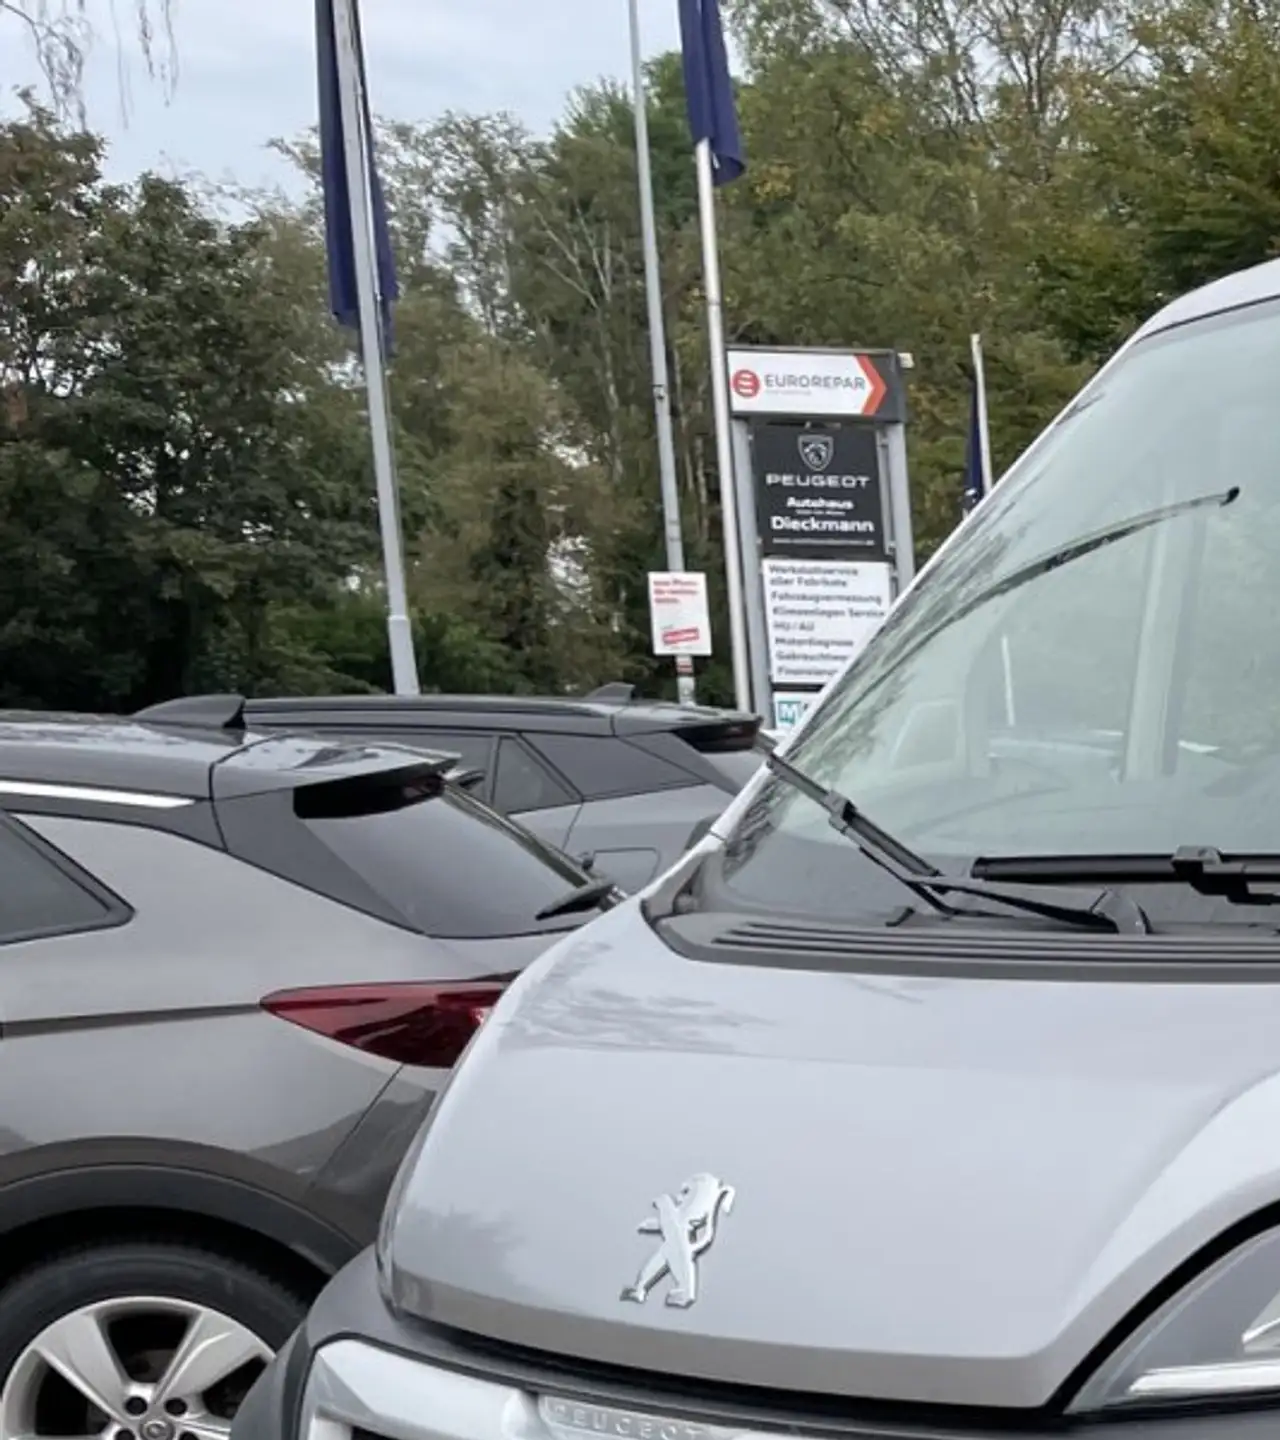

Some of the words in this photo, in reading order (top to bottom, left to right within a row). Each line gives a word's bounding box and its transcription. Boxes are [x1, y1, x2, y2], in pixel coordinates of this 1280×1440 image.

[764, 374, 866, 390] EUROREPAR
[766, 473, 870, 489] PEUGEOT
[786, 496, 854, 510] Autohaus
[770, 515, 875, 533] Dieckmann
